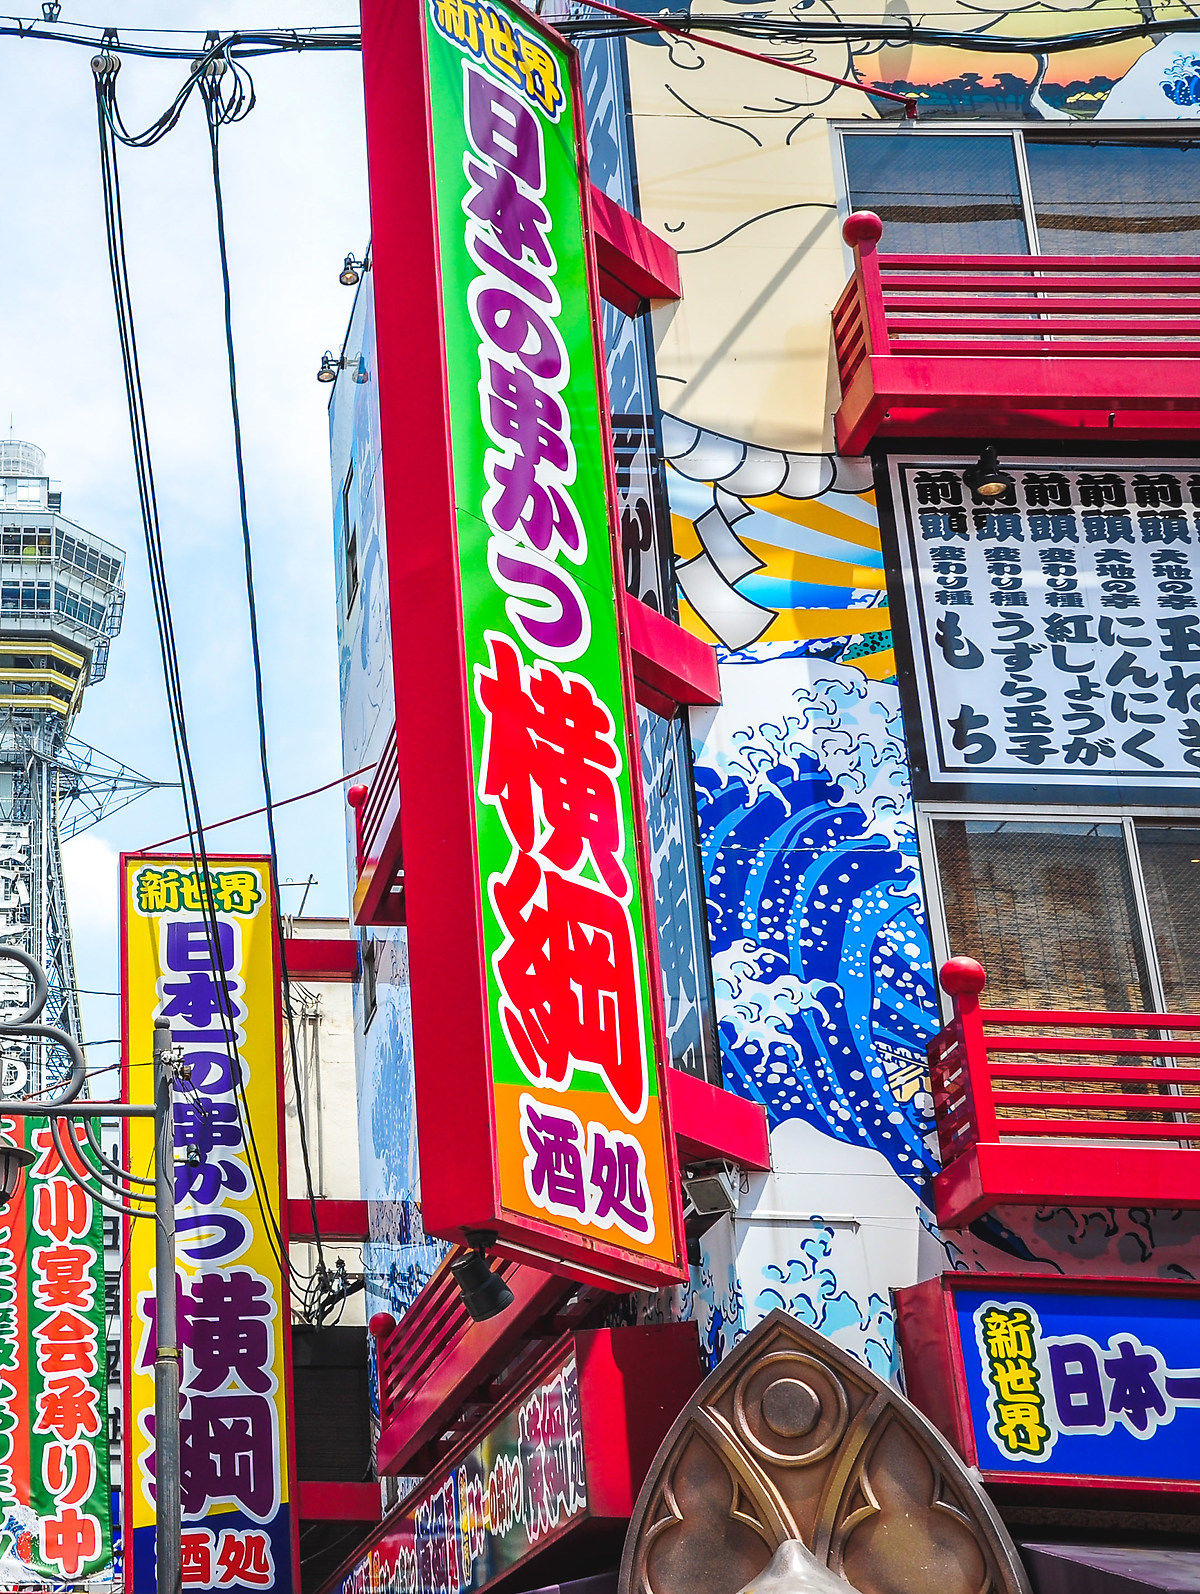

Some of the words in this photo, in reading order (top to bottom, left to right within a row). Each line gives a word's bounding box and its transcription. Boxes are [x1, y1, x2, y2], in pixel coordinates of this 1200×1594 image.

[434, 0, 562, 114] 新世界
[913, 470, 970, 541] 前頭
[1021, 472, 1079, 543] 前頭
[1076, 473, 1136, 544] 前頭
[1131, 474, 1192, 545] 前頭
[929, 545, 974, 606] 変わり種
[984, 546, 1030, 607] 変わり種
[1038, 547, 1085, 608] 変わり種
[1094, 548, 1142, 609] 大地の幸
[1150, 549, 1199, 610] 大地の幸
[934, 611, 997, 765] もち
[990, 611, 1059, 765] うずら玉子
[1040, 612, 1116, 766] 紅しょうが
[1098, 614, 1165, 769] にんにく
[138, 869, 261, 913] 新世界
[527, 1103, 649, 1234] 酒処
[31, 1116, 95, 1575] 大小宴会承り中
[983, 1308, 1049, 1453] 新世界
